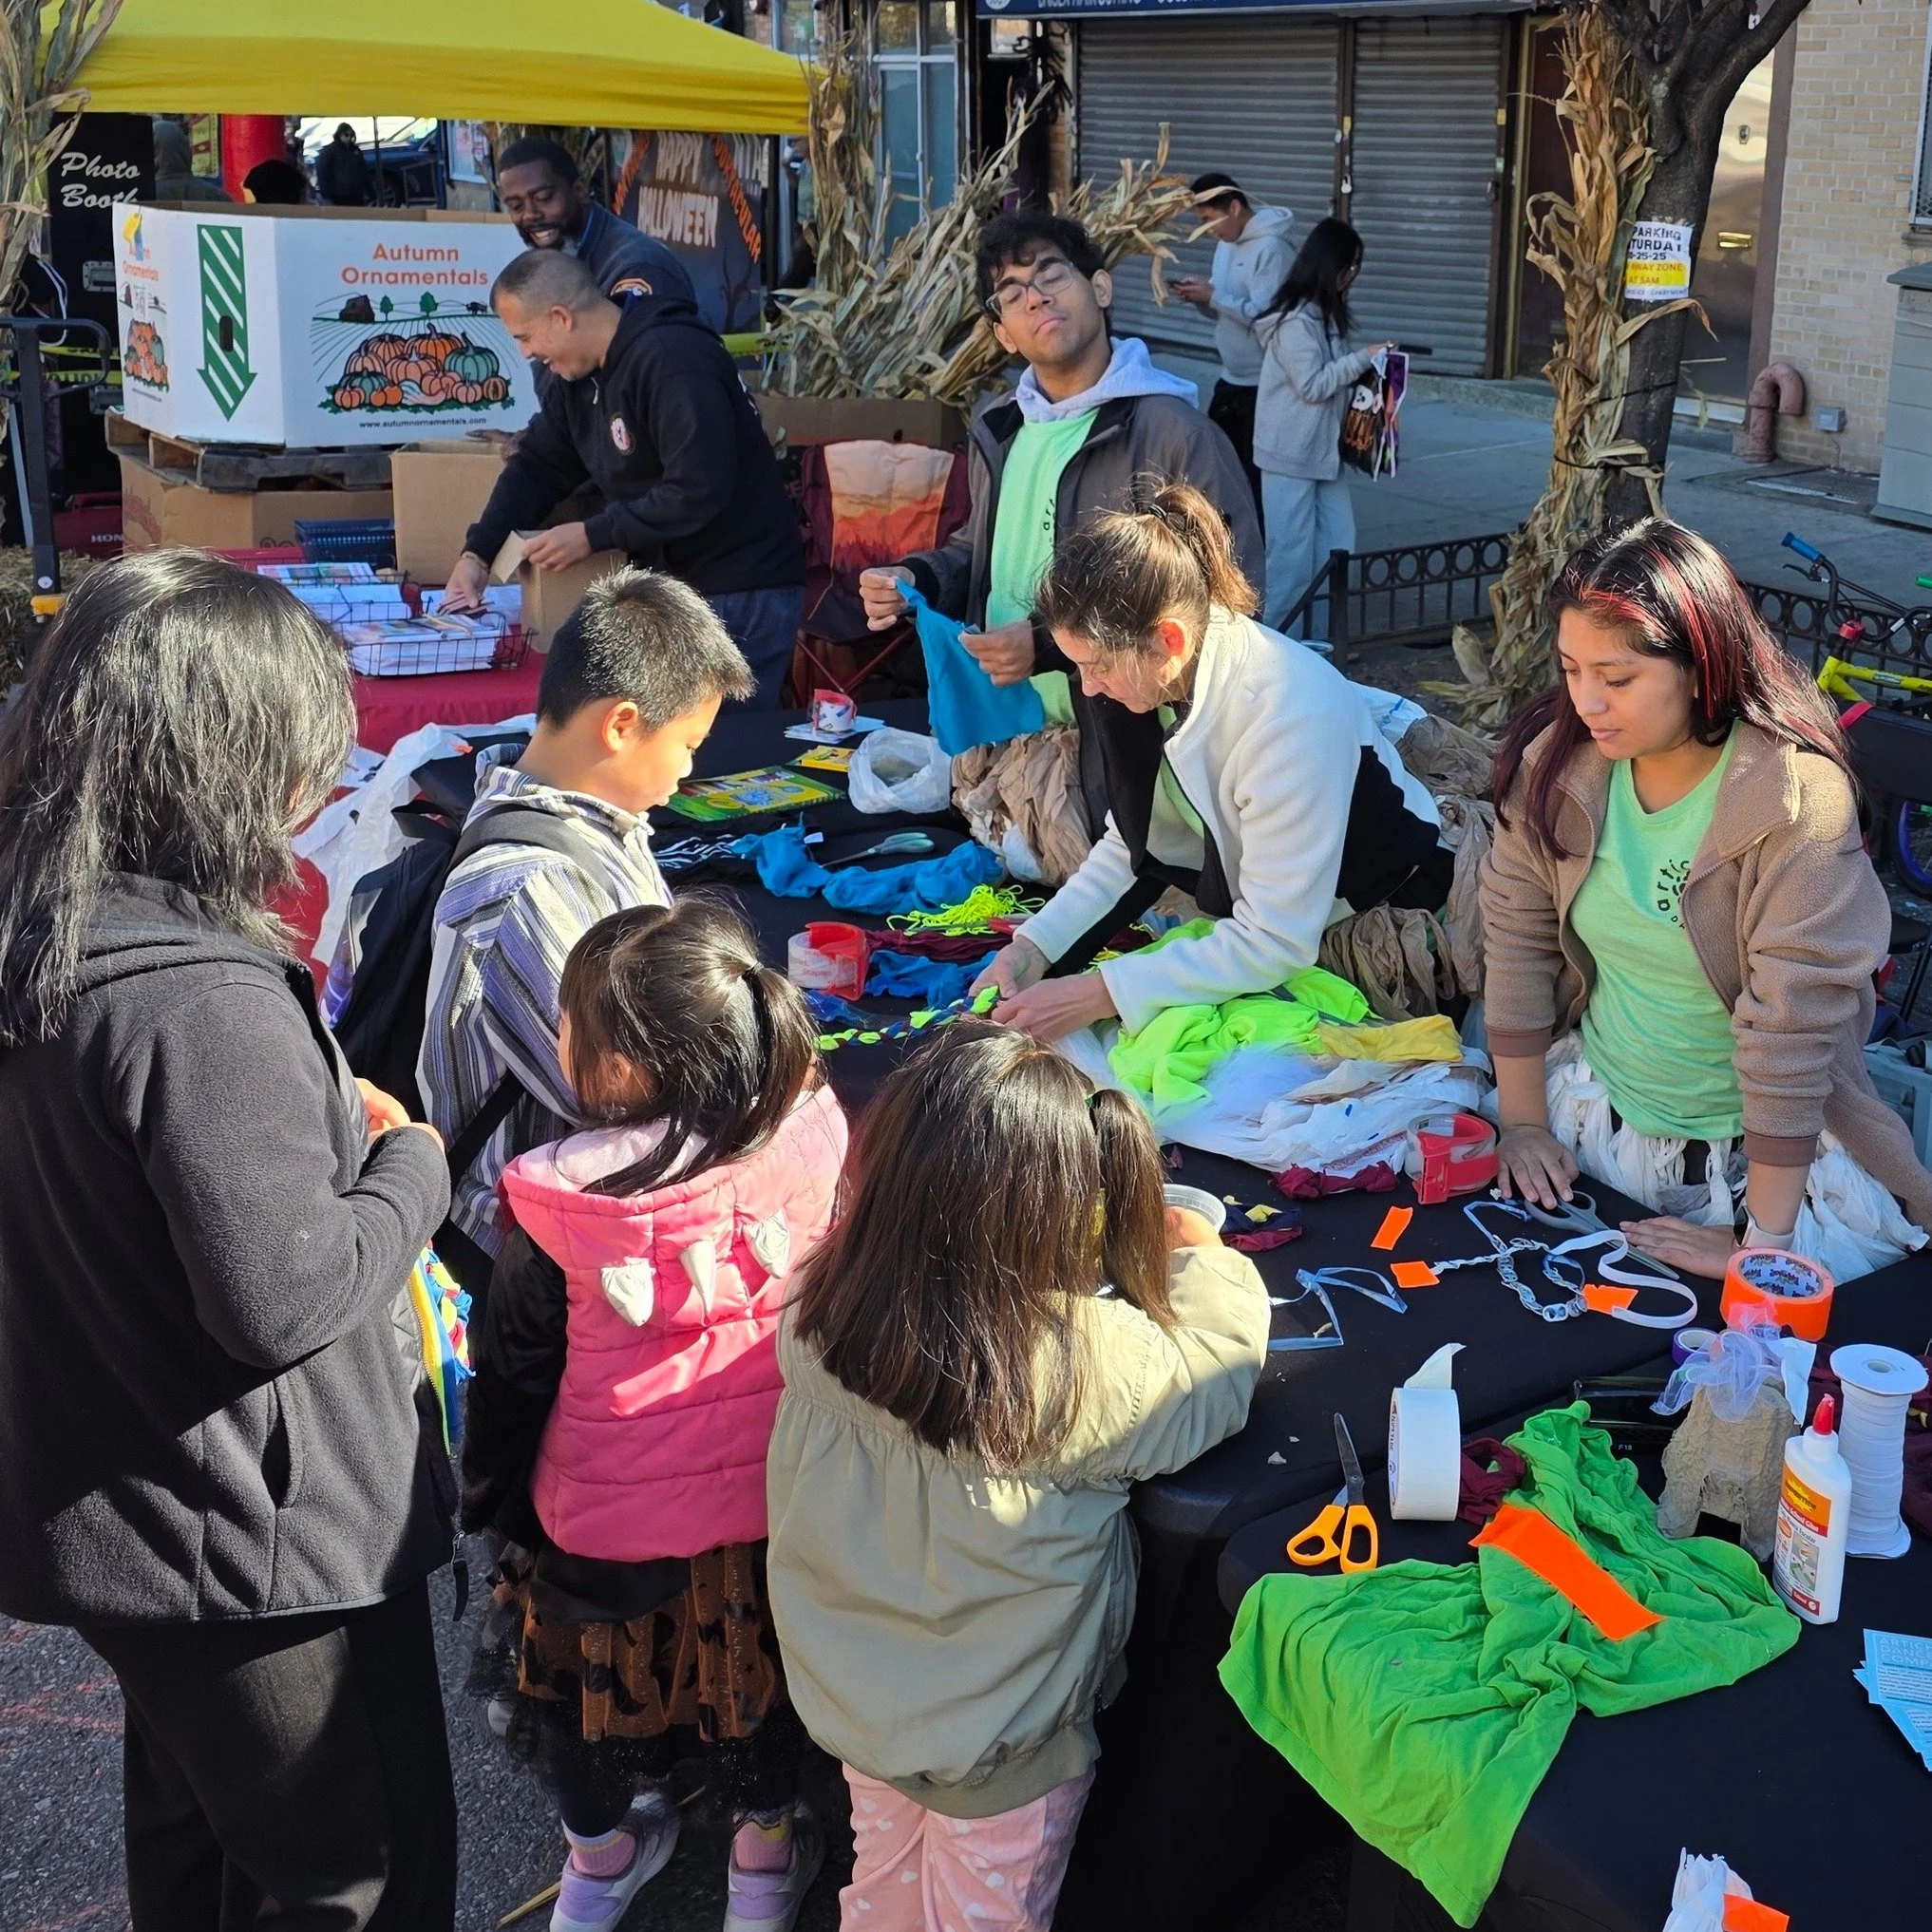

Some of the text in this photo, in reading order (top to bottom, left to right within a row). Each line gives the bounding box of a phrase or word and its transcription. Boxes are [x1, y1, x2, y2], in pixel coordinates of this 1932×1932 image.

[60, 152, 141, 180] Photo
[372, 242, 459, 261] Autumn
[341, 266, 488, 285] Ornamentals
[1657, 263, 1683, 272] ZONE
[359, 417, 487, 428] www.autumnornamentals.com
